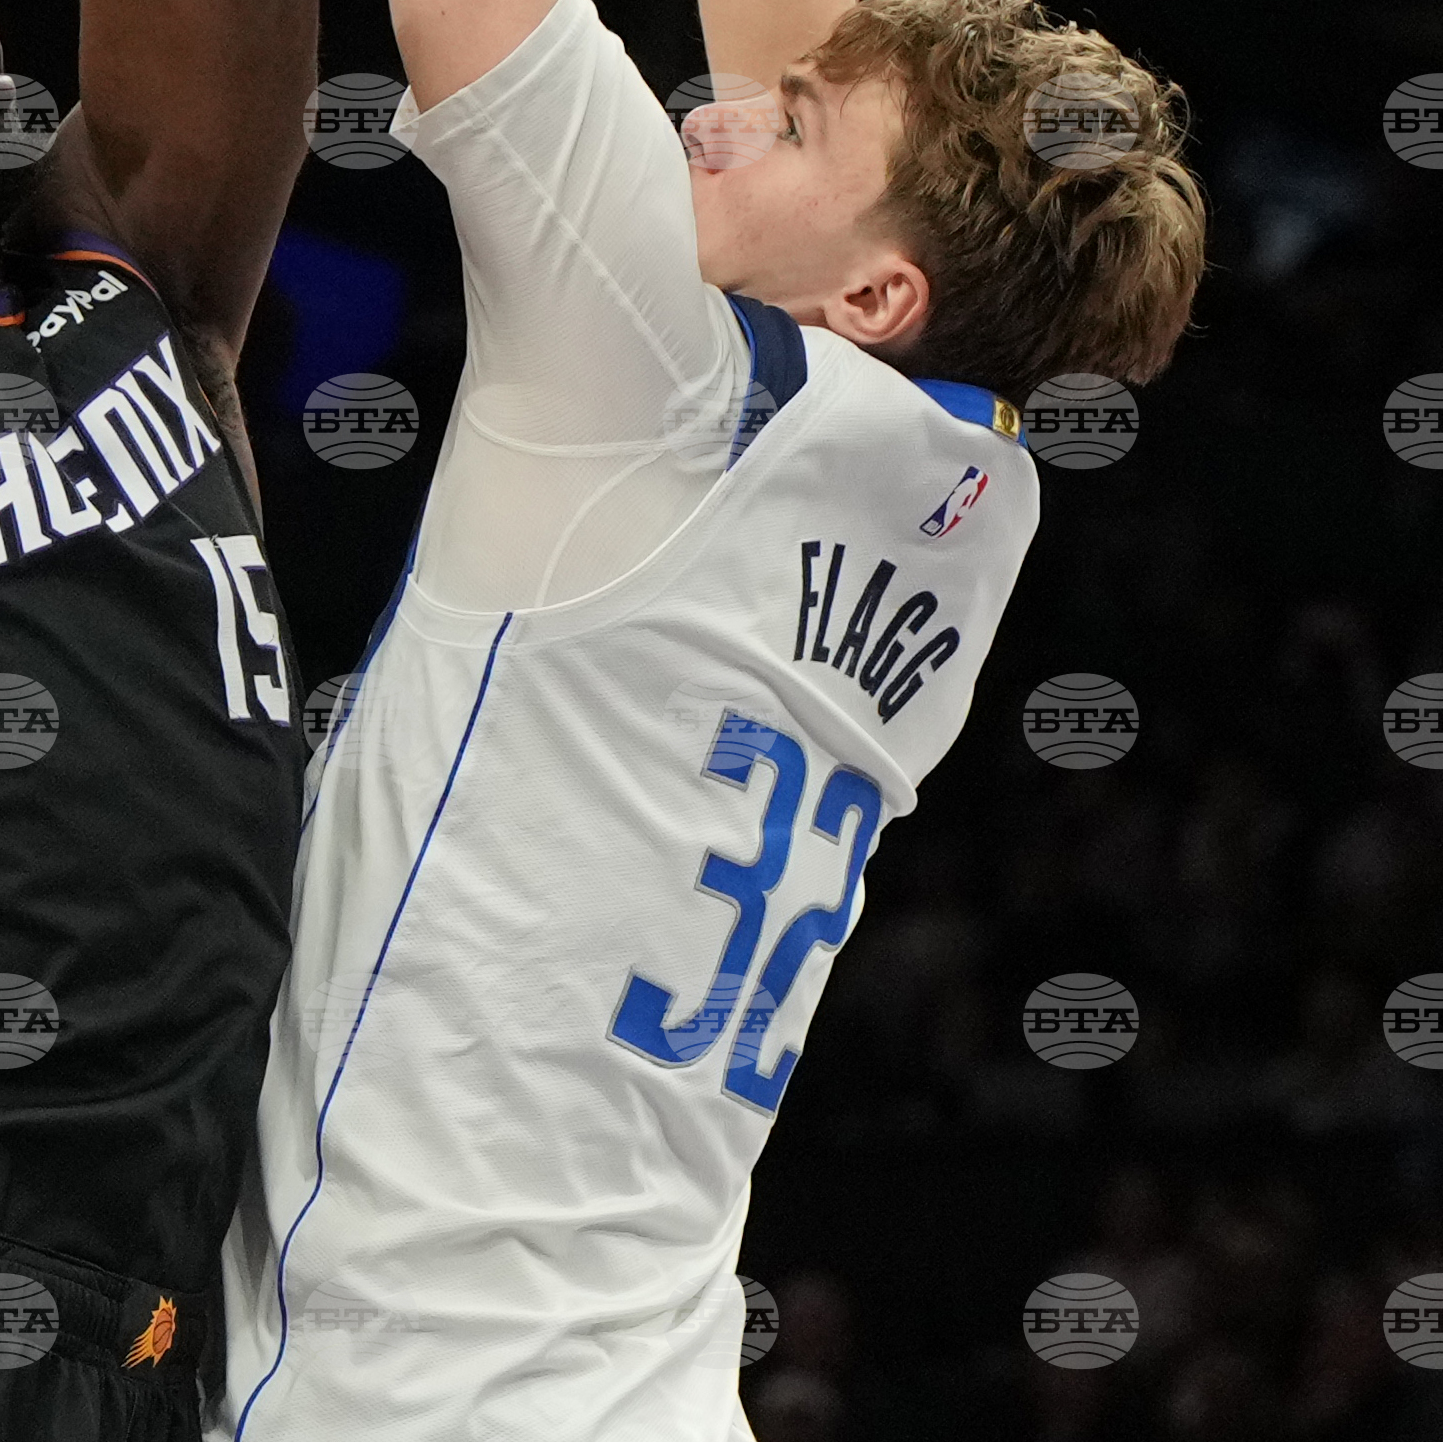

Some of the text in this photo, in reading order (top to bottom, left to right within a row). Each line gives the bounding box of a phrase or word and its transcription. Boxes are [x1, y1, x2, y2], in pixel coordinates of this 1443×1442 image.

[190, 534, 291, 727] 15
[793, 540, 960, 725] FLAGG
[604, 706, 883, 1120] 32
